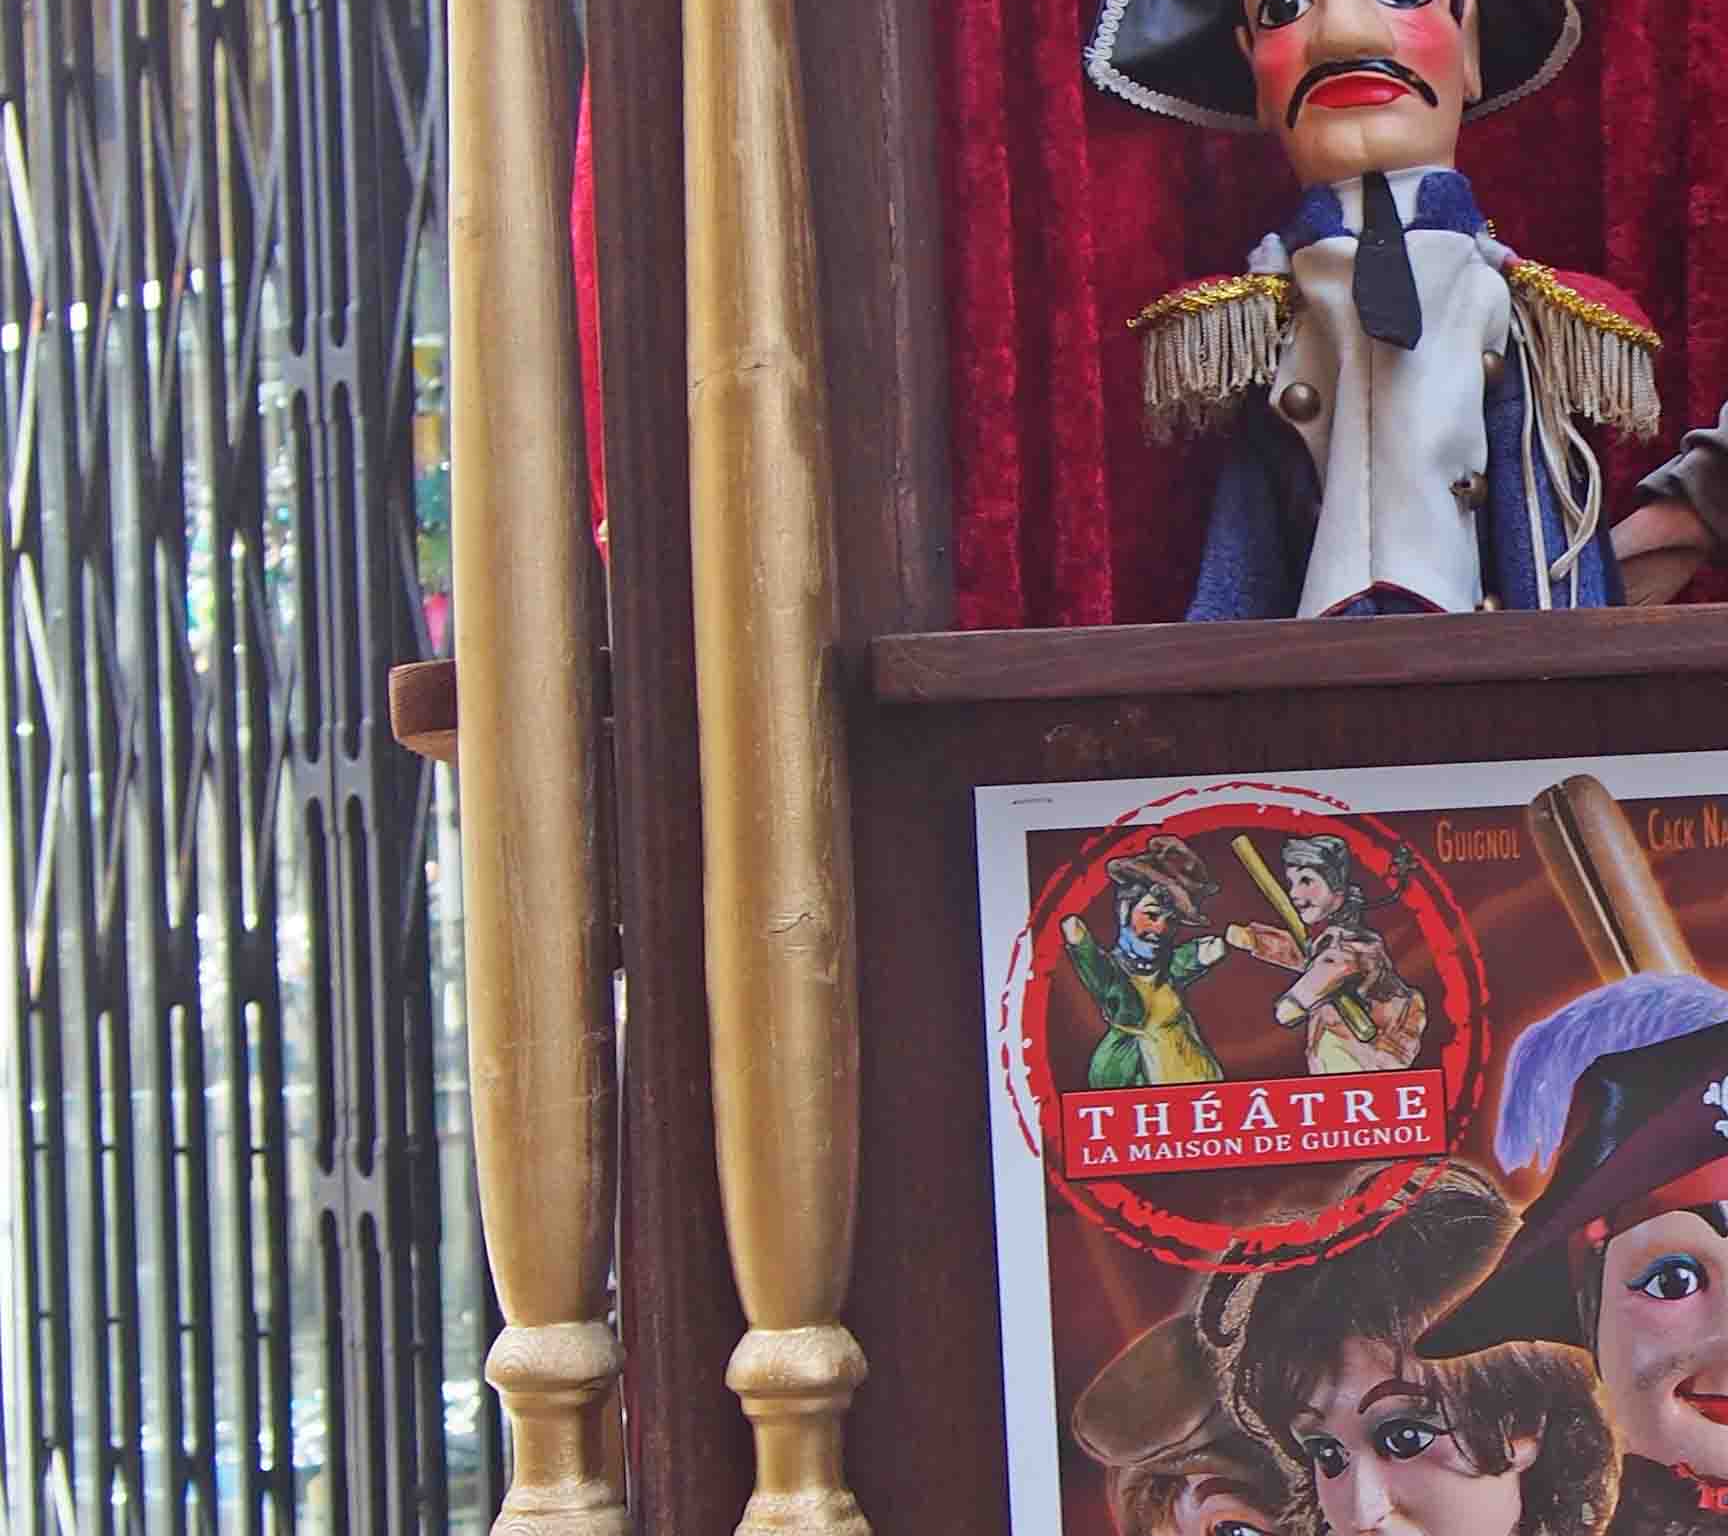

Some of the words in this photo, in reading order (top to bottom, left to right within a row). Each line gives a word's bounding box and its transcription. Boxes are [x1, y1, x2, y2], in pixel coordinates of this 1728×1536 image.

[1078, 1085, 1429, 1141] THÉÂTRE
[1083, 1144, 1120, 1165] LA
[1129, 1136, 1243, 1161] MAISON
[1255, 1132, 1292, 1153] DE
[1302, 1125, 1432, 1151] GUIGNOL
